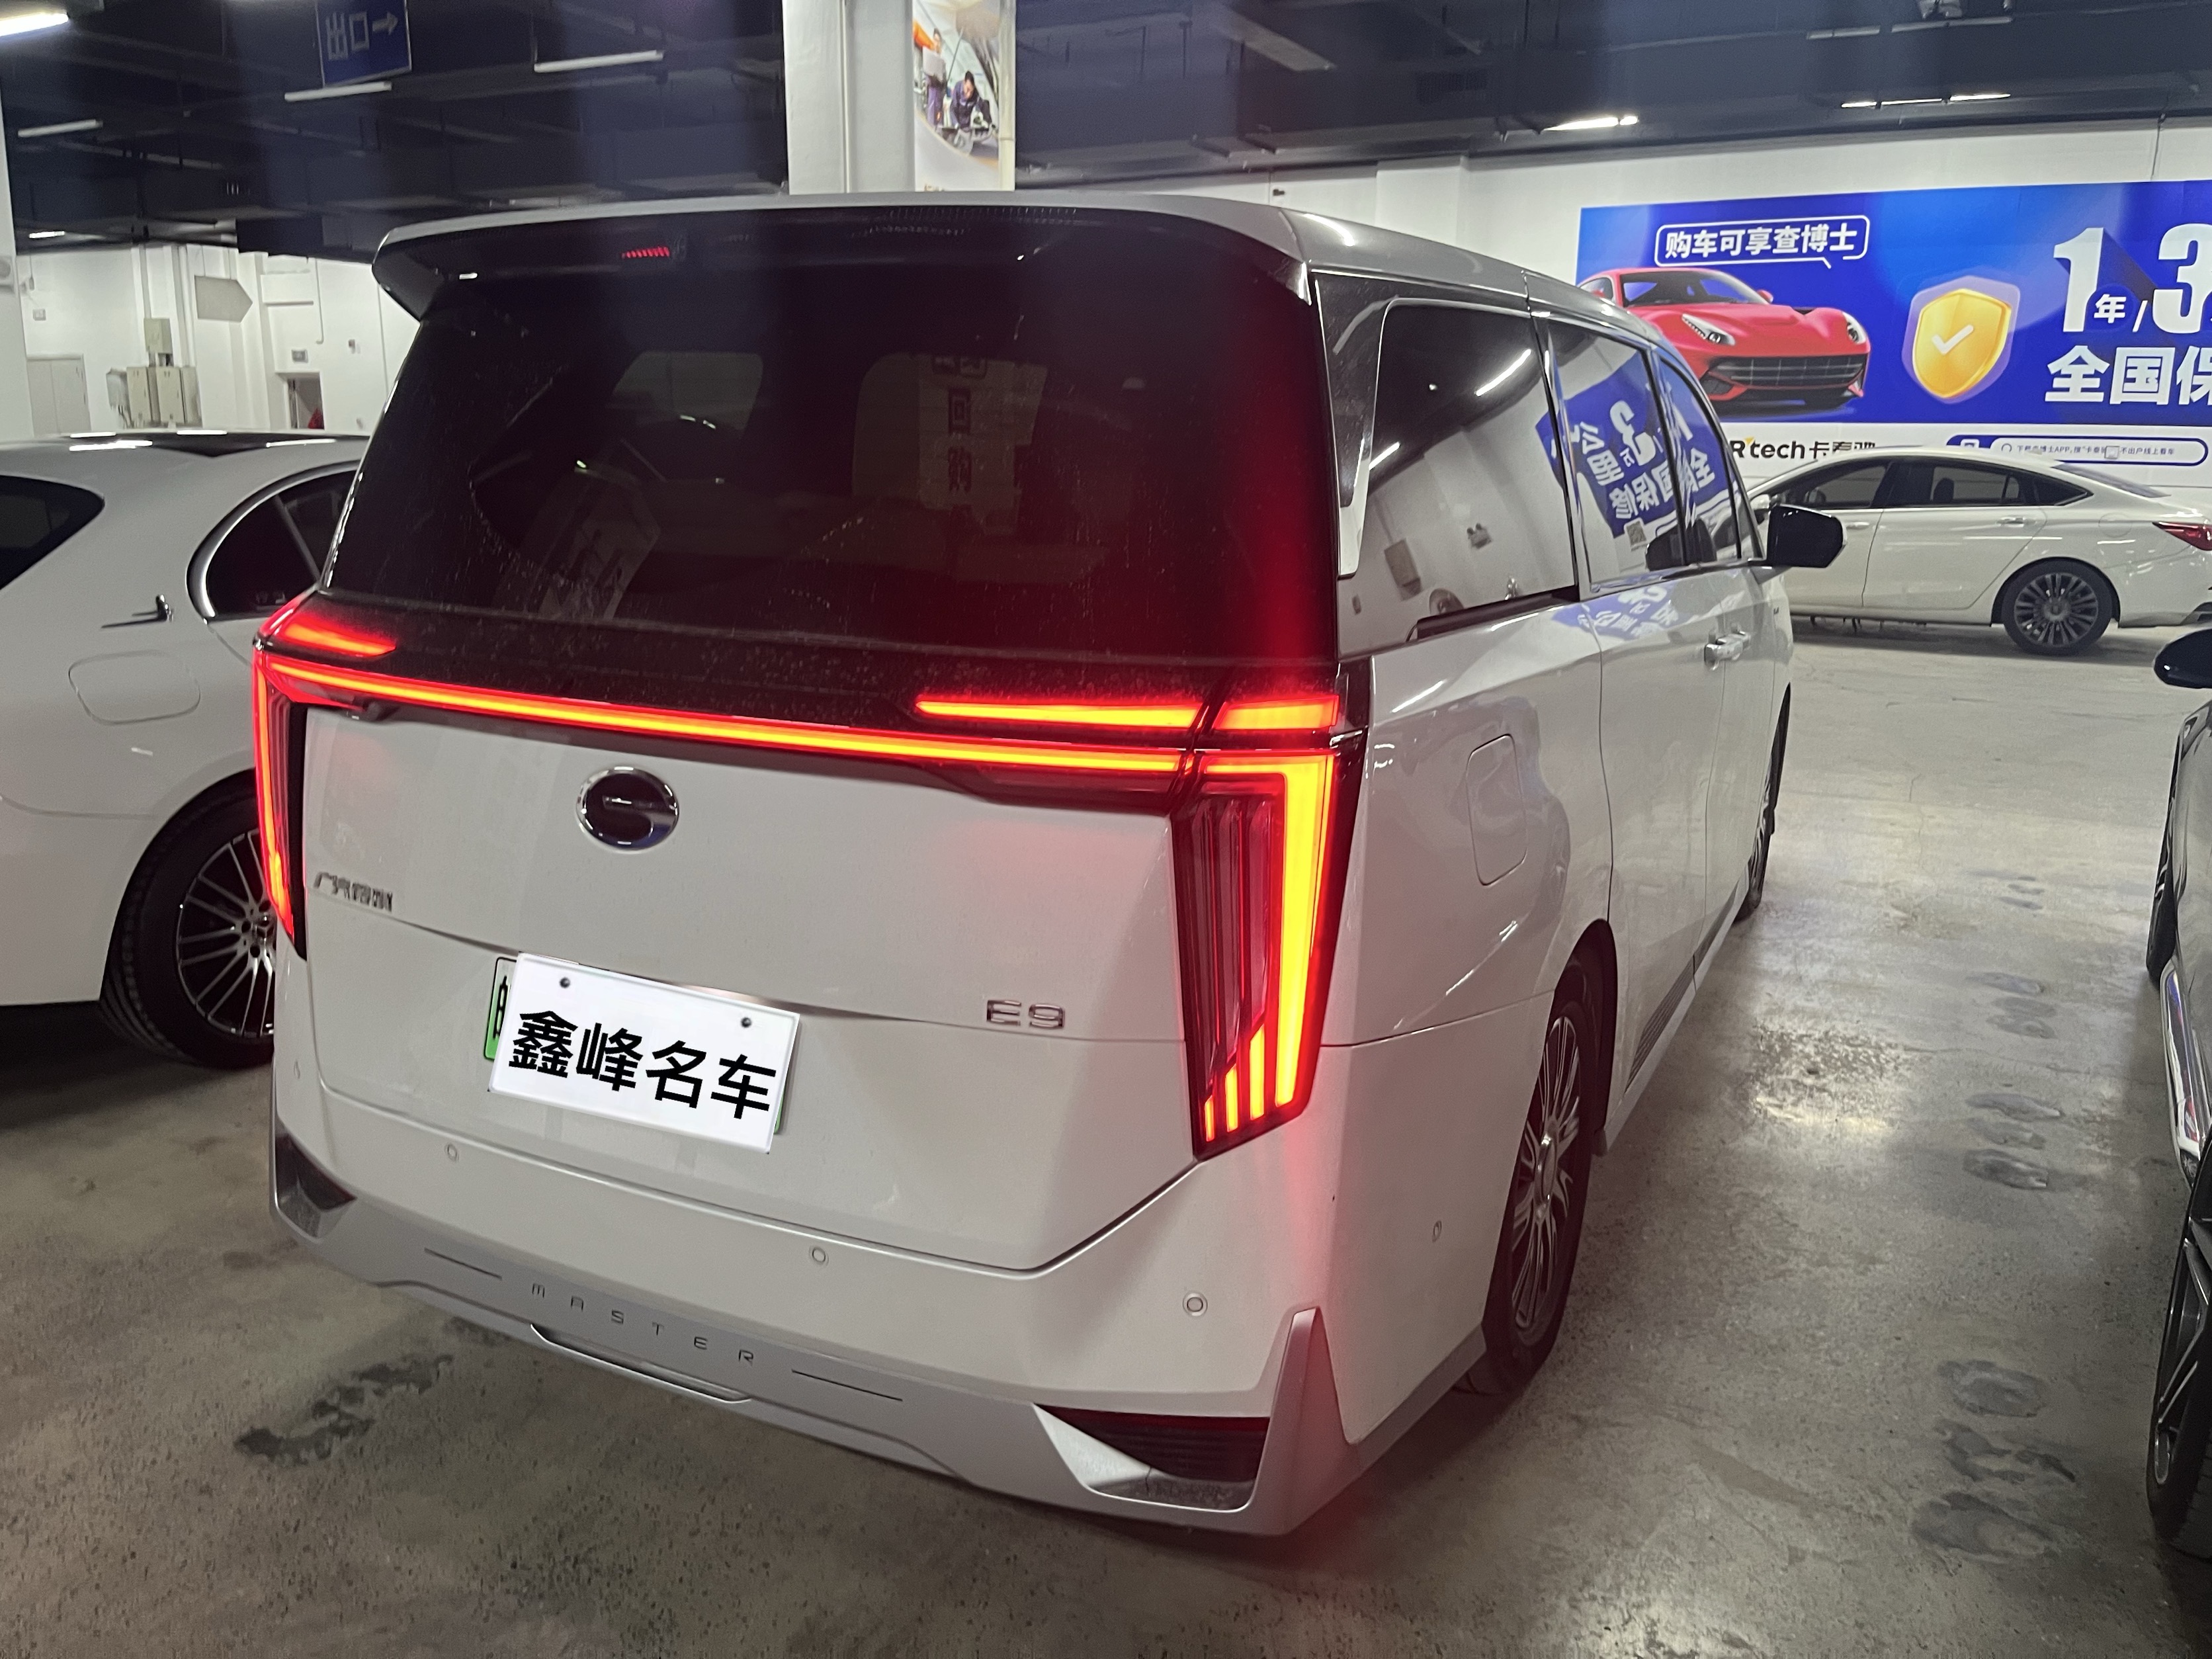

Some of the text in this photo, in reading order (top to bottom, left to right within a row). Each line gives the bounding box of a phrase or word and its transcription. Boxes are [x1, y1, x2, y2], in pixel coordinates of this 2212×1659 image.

[325, 11, 370, 60] 出口
[1665, 222, 1857, 259] 购车可享查博士
[986, 1000, 1066, 1029] E9
[531, 1282, 754, 1367] MASTER
